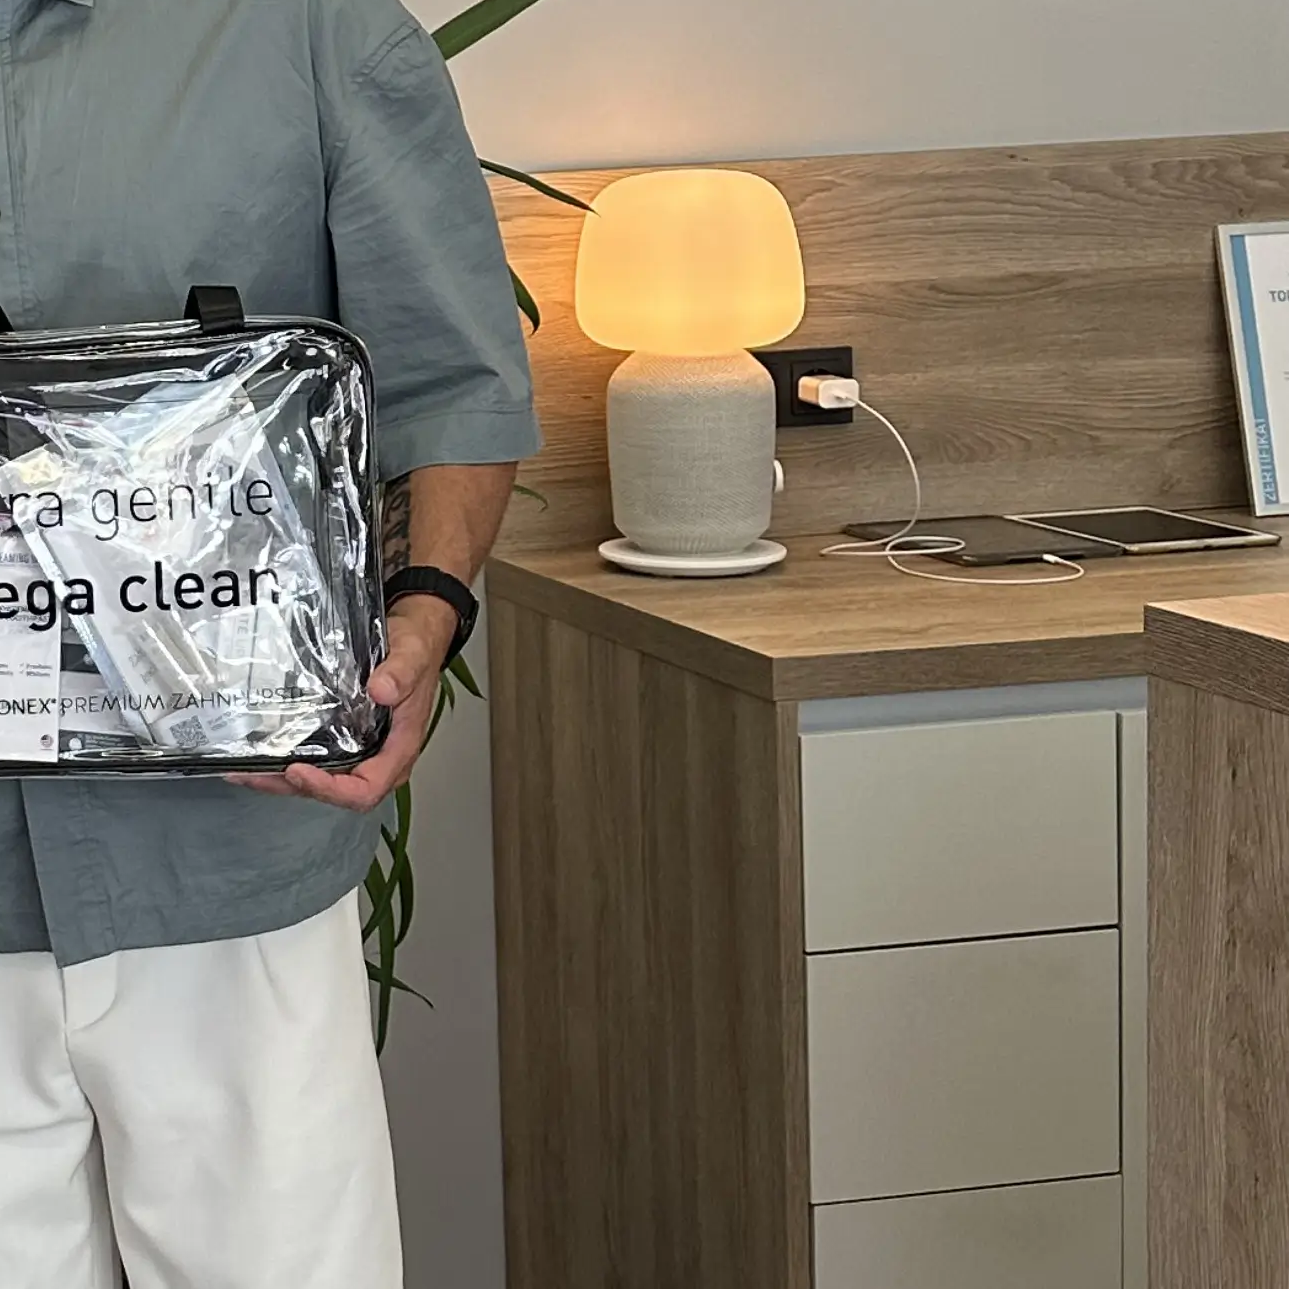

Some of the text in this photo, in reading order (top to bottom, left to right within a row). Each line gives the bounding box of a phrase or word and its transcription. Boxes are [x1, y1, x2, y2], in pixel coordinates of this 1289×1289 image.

[1269, 289, 1289, 303] TO
[119, 561, 280, 613] clean
[60, 693, 166, 714] PREMIUM
